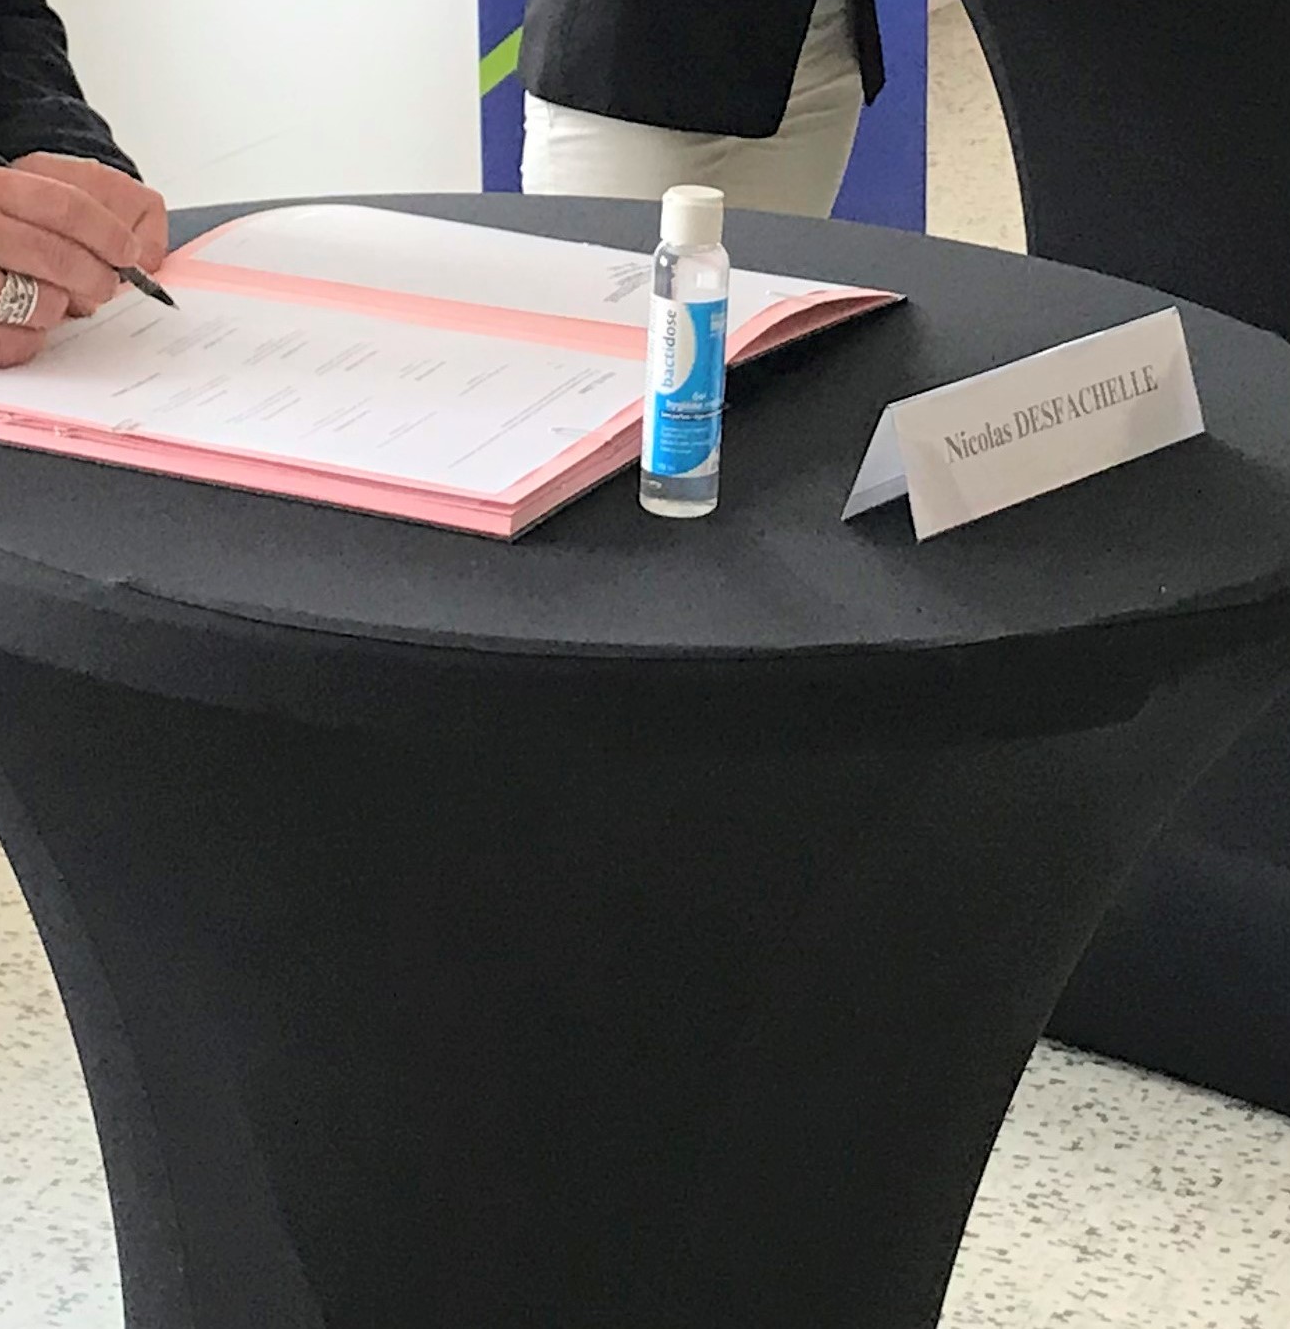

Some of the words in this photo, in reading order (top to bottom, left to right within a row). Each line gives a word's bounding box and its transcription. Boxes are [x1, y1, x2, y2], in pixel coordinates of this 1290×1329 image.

[662, 309, 678, 388] bactidose
[944, 421, 1013, 463] Nicolas
[1013, 365, 1159, 439] DESFACHELLE
